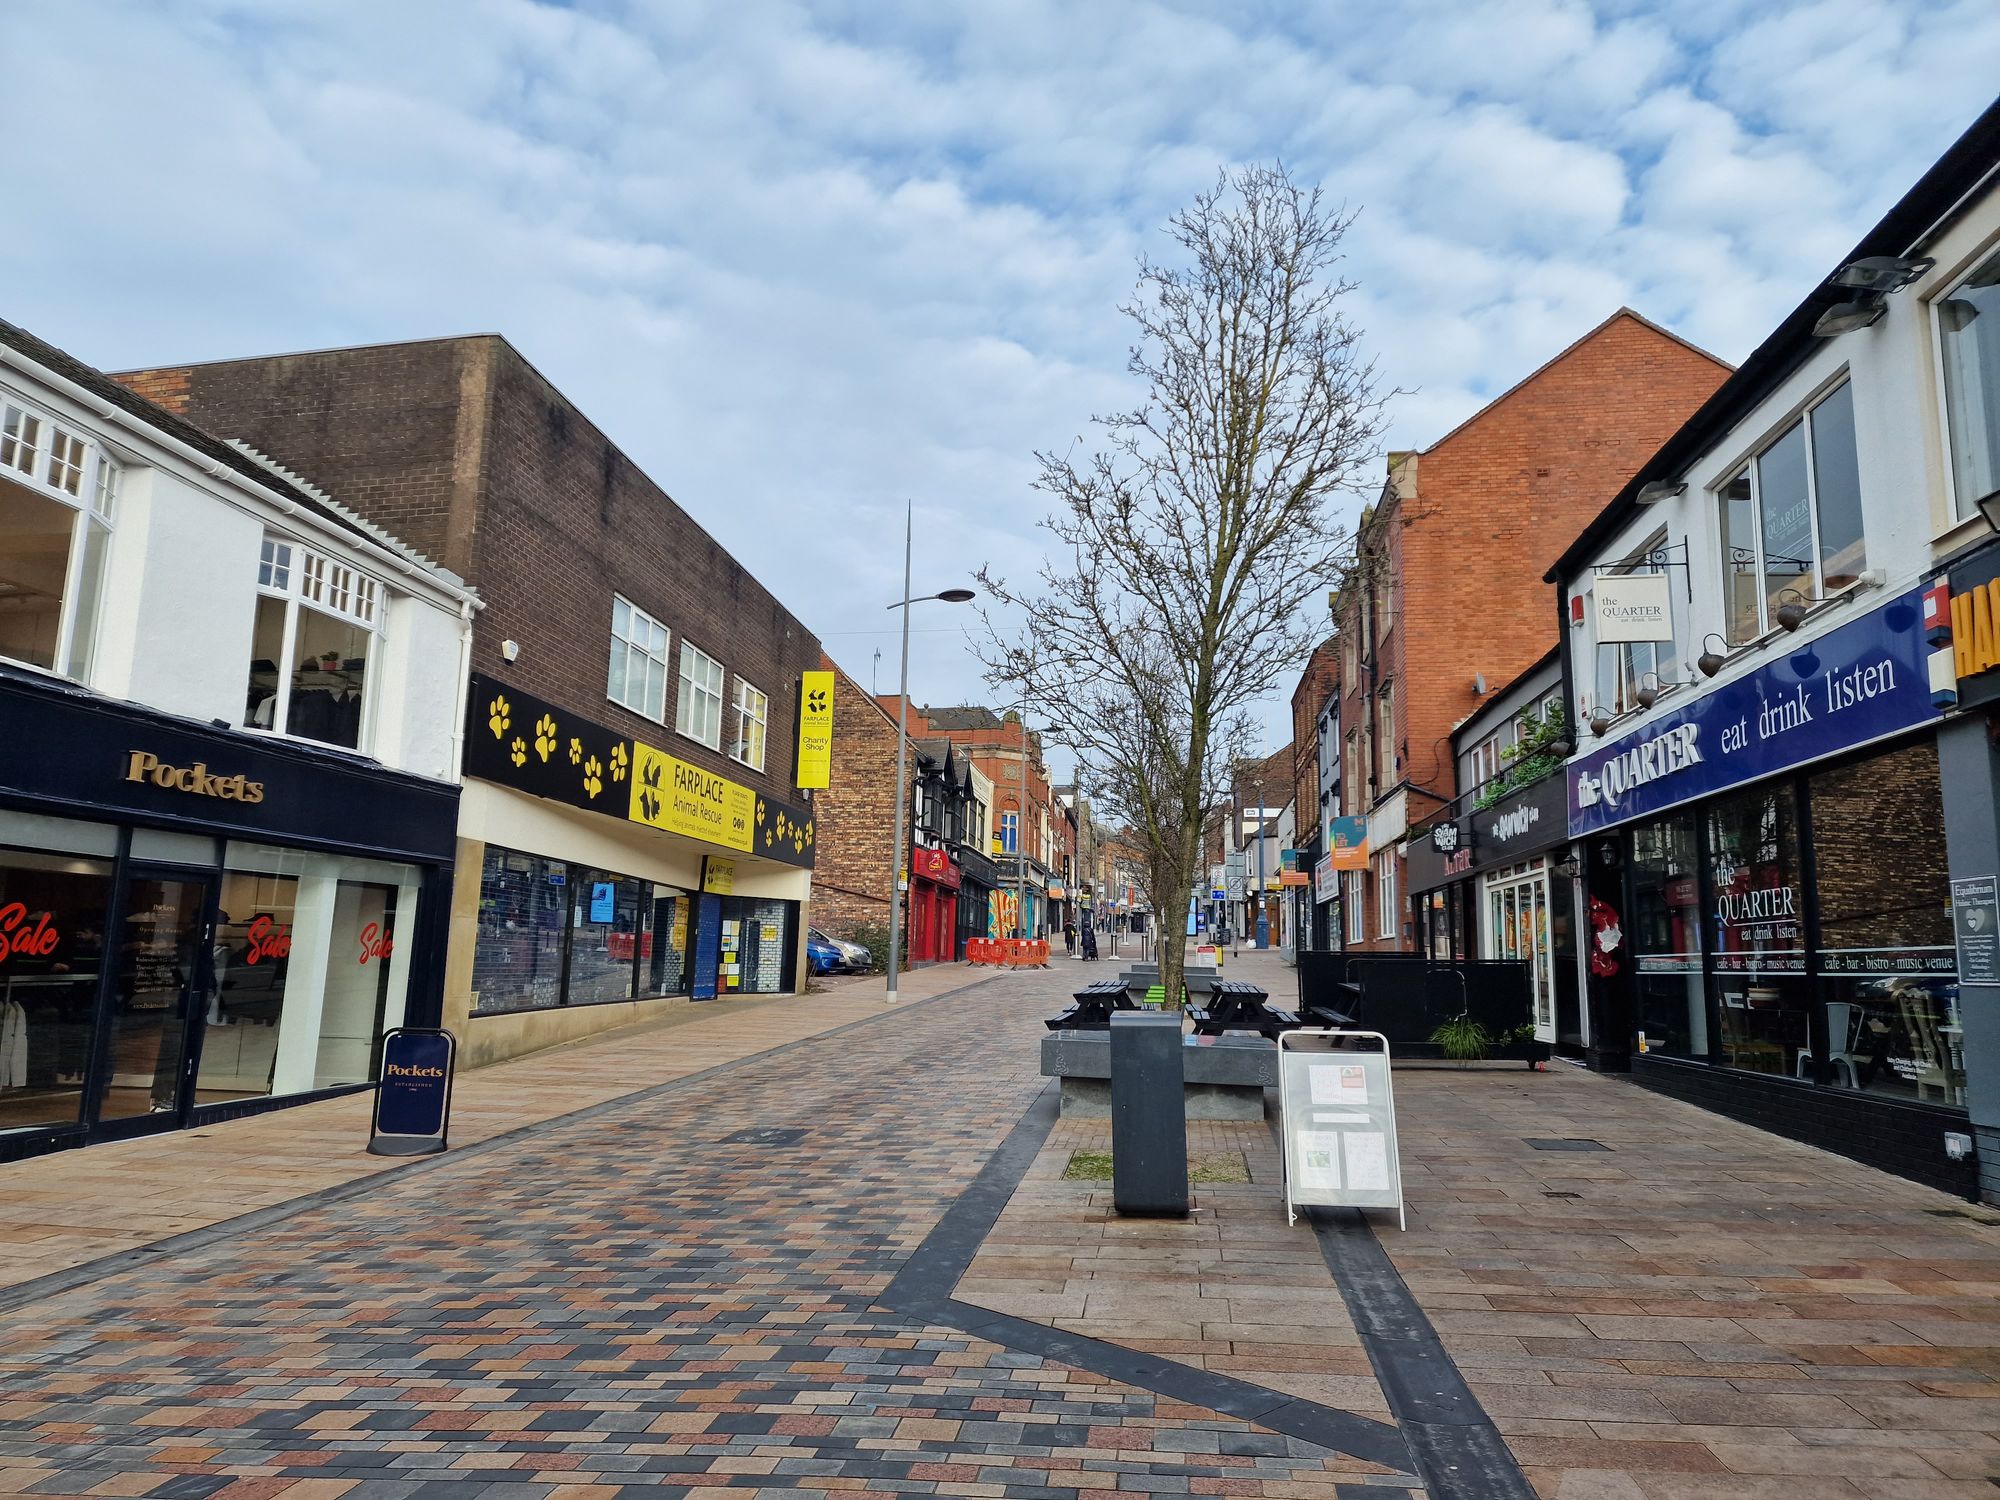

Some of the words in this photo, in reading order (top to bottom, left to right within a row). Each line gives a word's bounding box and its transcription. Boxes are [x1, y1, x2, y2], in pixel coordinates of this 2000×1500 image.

[1767, 498, 1809, 540] QUARTER
[1602, 597, 1618, 606] the
[1602, 606, 1662, 618] QUARTER
[1721, 715, 1748, 754] eat
[1759, 683, 1813, 740] drink
[1825, 659, 1896, 714] listen
[802, 736, 829, 745] Charity
[805, 743, 824, 752] Shop
[125, 750, 265, 804] Pockets
[1578, 771, 1600, 809] the
[1602, 723, 1703, 807] QUARTER
[674, 765, 724, 804] FARPLACE
[673, 795, 699, 818] Animal
[700, 803, 722, 825] Rescue
[1434, 828, 1457, 838] SLAM
[1434, 837, 1457, 847] WICH
[1716, 860, 1736, 887] the
[1955, 884, 1993, 897] Equilibrium
[1718, 886, 1796, 927] QUARTER
[0, 902, 60, 962] Sale
[247, 916, 292, 965] Sale
[359, 921, 394, 965] Sale
[1741, 928, 1752, 941] eat
[1754, 925, 1773, 940] drink
[1776, 923, 1797, 939] listen
[1716, 957, 1728, 969] cafe
[1786, 959, 1806, 969] venue
[1824, 956, 1840, 970] cafe
[1846, 956, 1859, 969] bar
[1865, 955, 1889, 970] bistro
[1896, 954, 1923, 969] music
[1925, 957, 1953, 969] venue
[387, 1064, 443, 1077] Pockets
